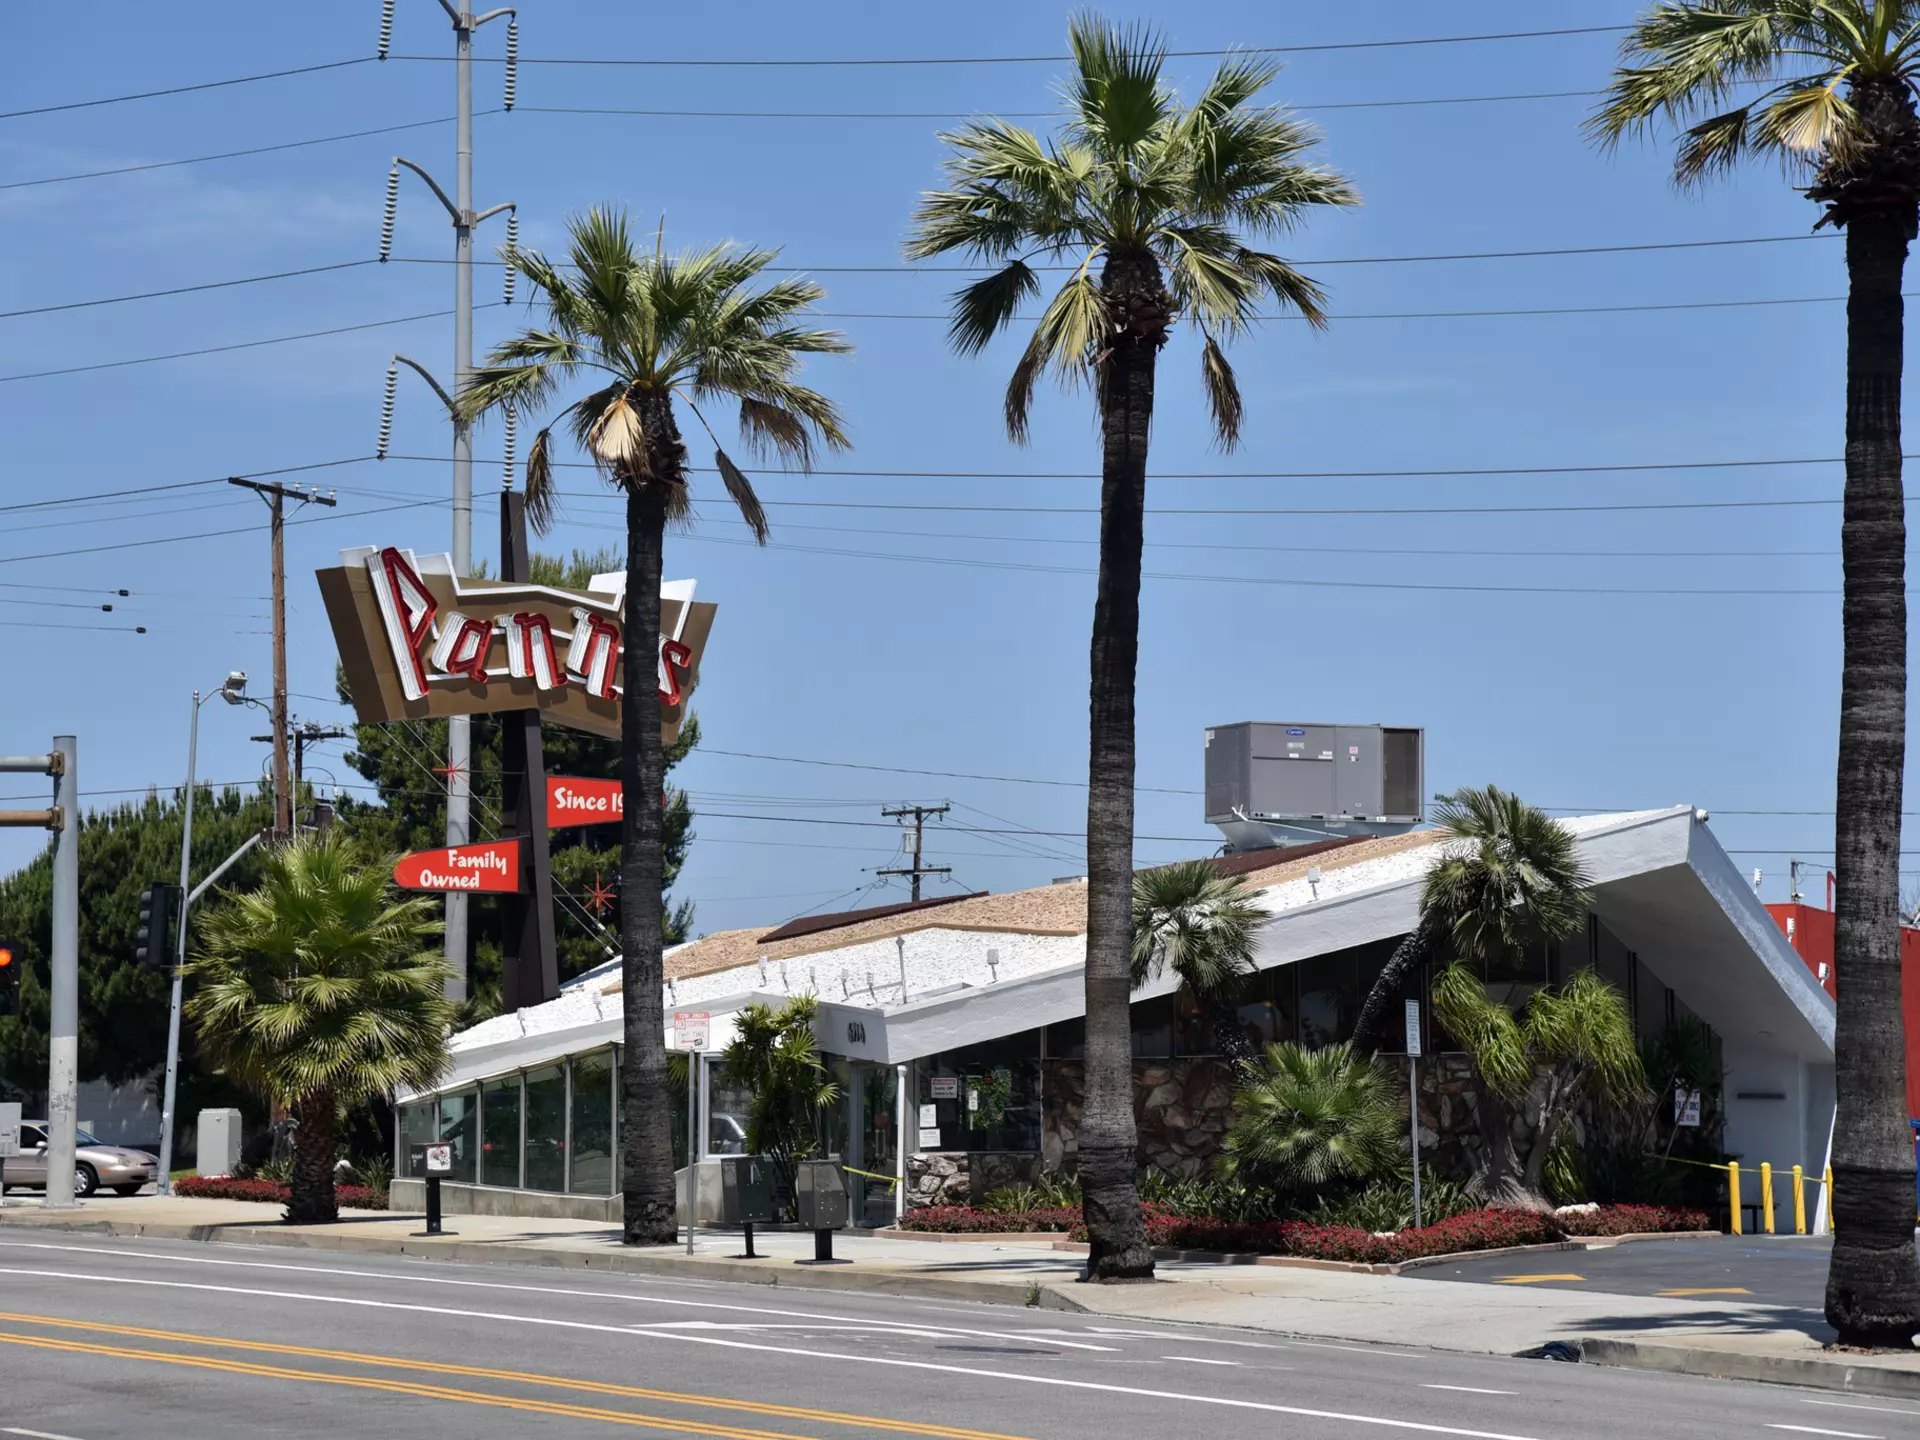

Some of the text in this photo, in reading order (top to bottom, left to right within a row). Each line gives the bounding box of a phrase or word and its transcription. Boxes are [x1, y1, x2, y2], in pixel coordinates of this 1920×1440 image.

[364, 546, 692, 705] Panns
[554, 787, 607, 811] Since
[448, 849, 507, 875] Family
[420, 869, 480, 888] Owned
[675, 1020, 685, 1029] NO
